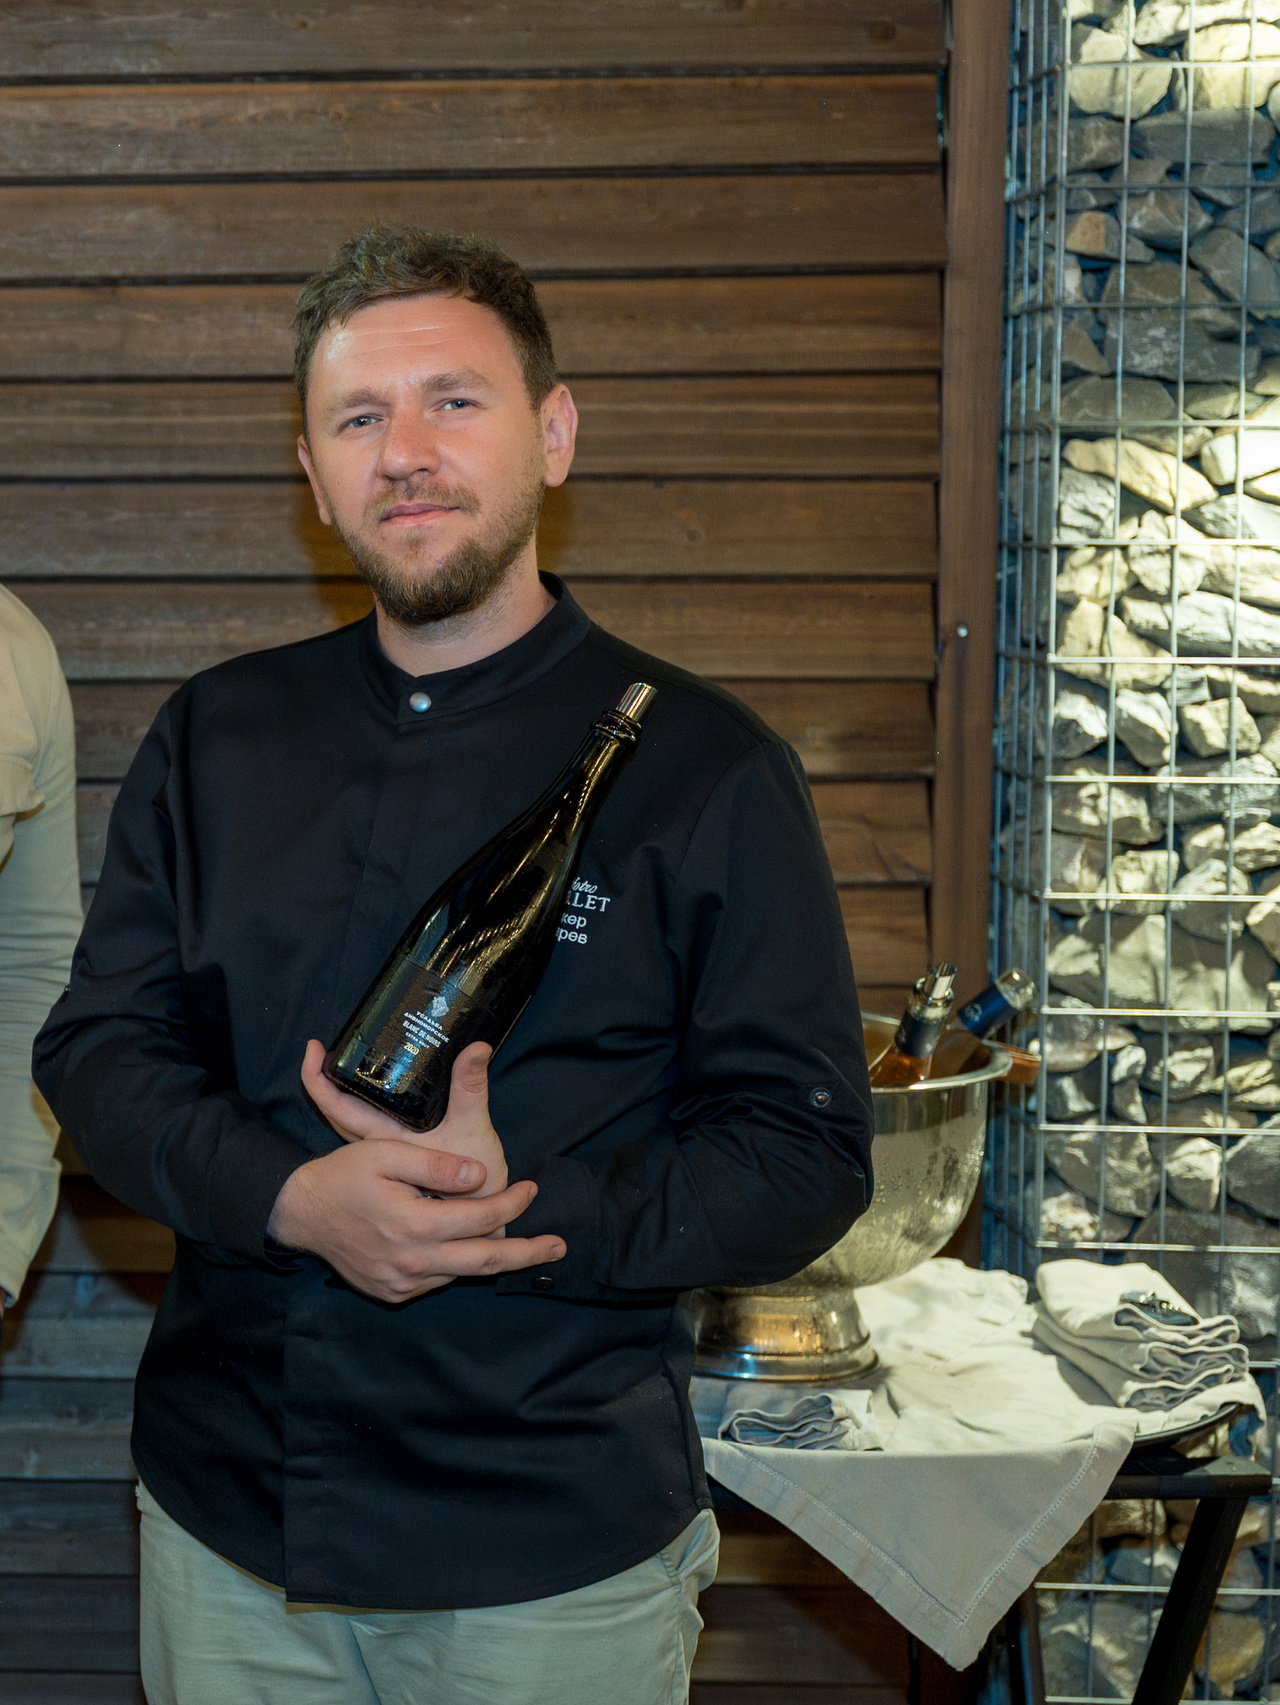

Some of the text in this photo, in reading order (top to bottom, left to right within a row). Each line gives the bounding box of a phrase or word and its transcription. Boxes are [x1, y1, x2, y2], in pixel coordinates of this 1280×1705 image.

[567, 892, 611, 912] LET
[557, 927, 588, 945] рев
[403, 1020, 441, 1048] BLANC DE NOIRS
[403, 1042, 420, 1055] 2020
